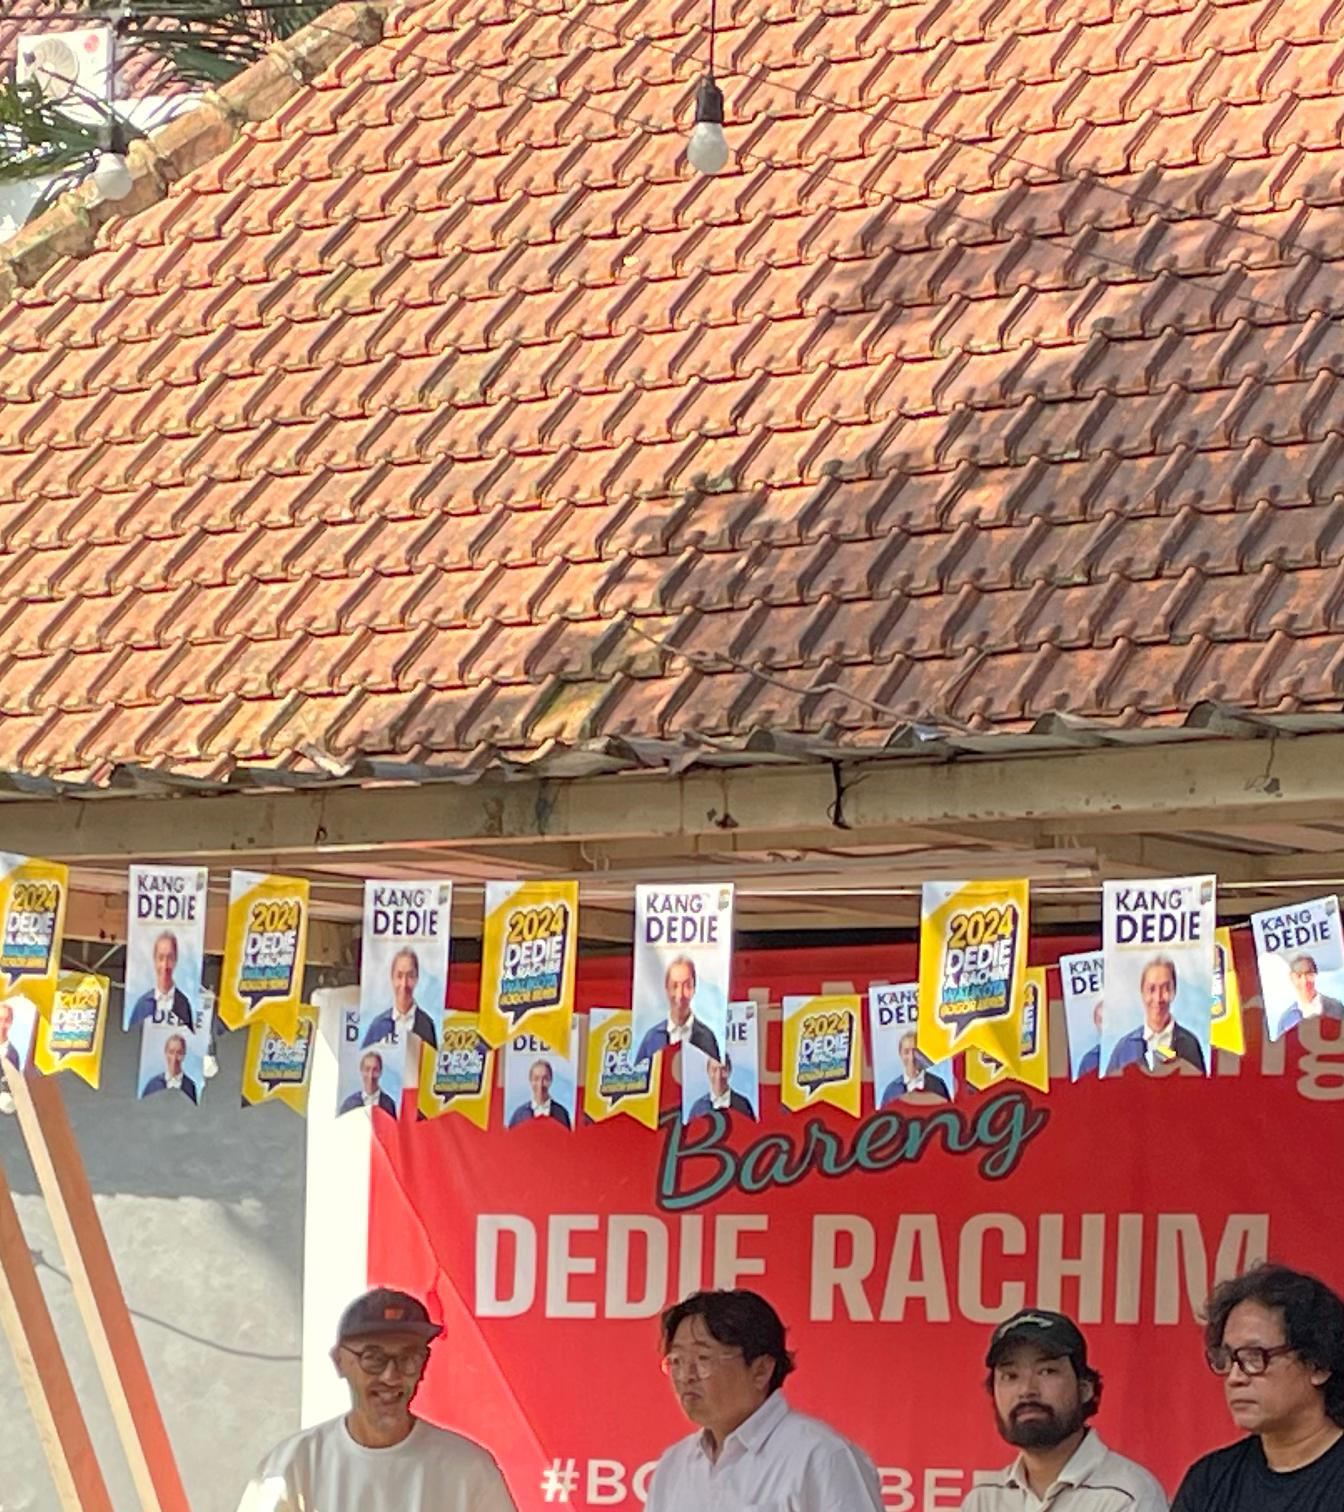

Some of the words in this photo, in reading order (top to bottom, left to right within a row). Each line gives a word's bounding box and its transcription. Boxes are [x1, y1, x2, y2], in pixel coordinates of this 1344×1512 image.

[12, 882, 58, 912] 2024
[136, 874, 185, 894] KANG
[373, 887, 425, 908] KANG
[136, 893, 196, 921] DEDIE
[646, 893, 704, 914] KANG
[1115, 888, 1183, 911] KANG
[7, 912, 55, 934] DEDIE
[251, 902, 299, 931] 2024
[372, 908, 439, 936] DEDIE
[507, 903, 565, 943] 2024
[645, 914, 719, 944] DEDIE
[949, 904, 1014, 948] 2024
[1115, 910, 1201, 945] DEDIE
[1260, 909, 1312, 932] KANG
[504, 934, 564, 967] DEDIE
[1263, 920, 1332, 953] DEDIE
[946, 938, 1012, 974] DEDIE
[1069, 957, 1104, 976] KAN
[803, 1011, 850, 1038] 2024
[879, 1004, 919, 1025] DED
[443, 1029, 479, 1050] 202
[661, 1090, 1047, 1209] Bareng
[808, 1212, 1272, 1327] RACHIM
